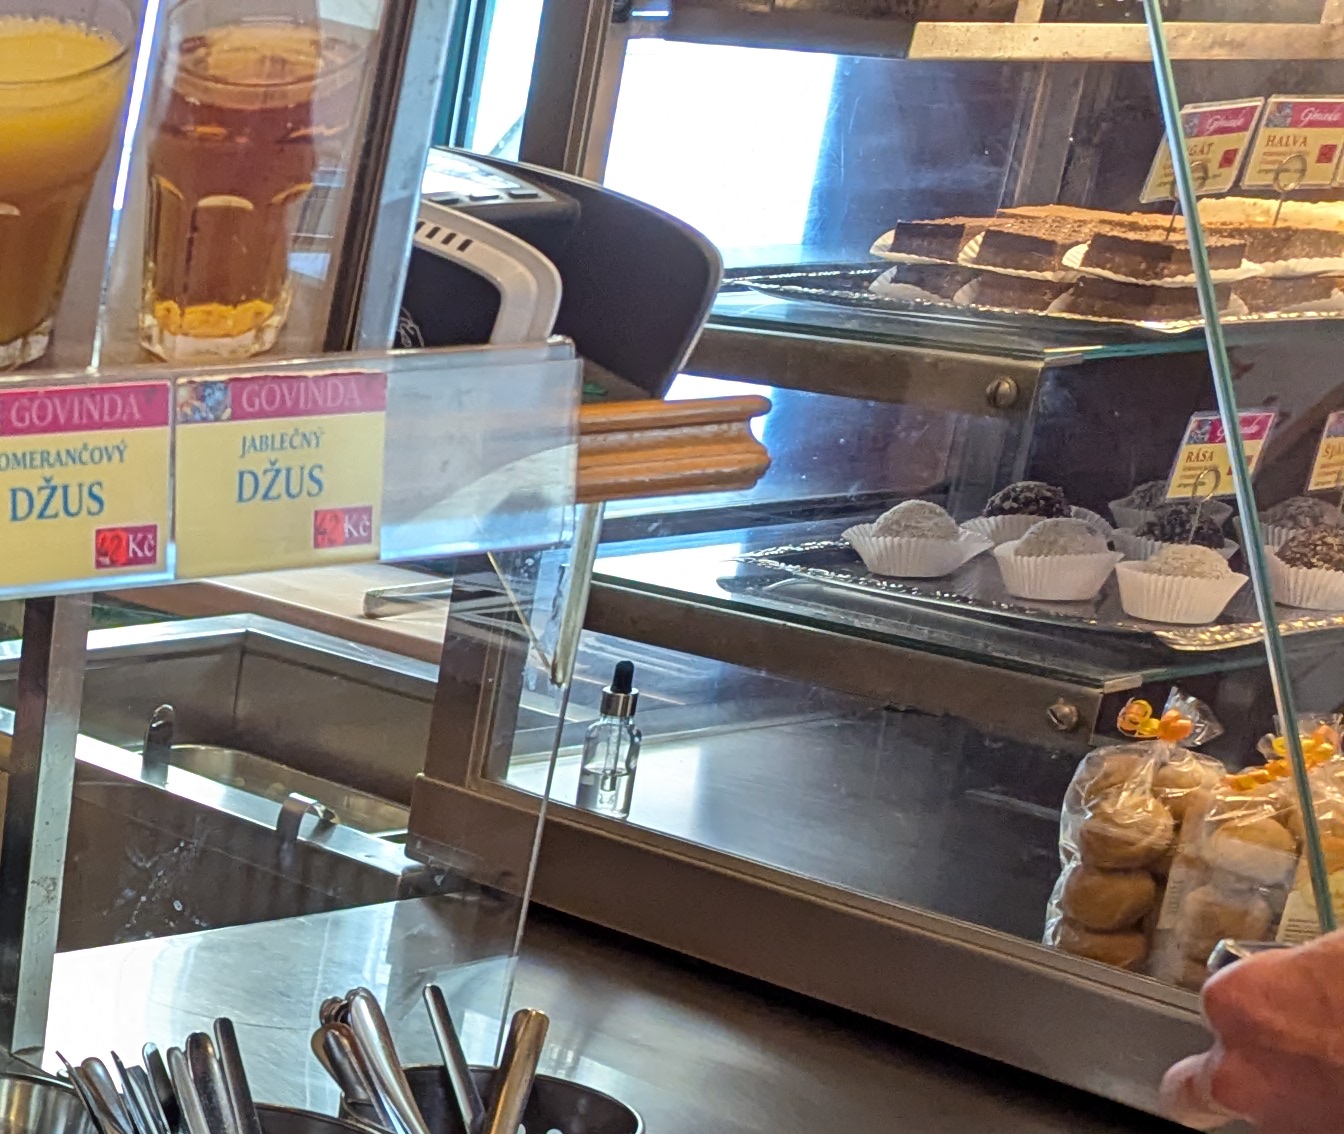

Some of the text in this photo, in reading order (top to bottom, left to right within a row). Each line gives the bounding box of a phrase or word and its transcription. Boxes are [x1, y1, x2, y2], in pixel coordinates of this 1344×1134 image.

[239, 425, 325, 459] JABLEČNÝ
[236, 458, 325, 504] DŽUS
[8, 475, 105, 523] DŽUS
[344, 513, 371, 538] Kč
[128, 531, 156, 559] Kč
